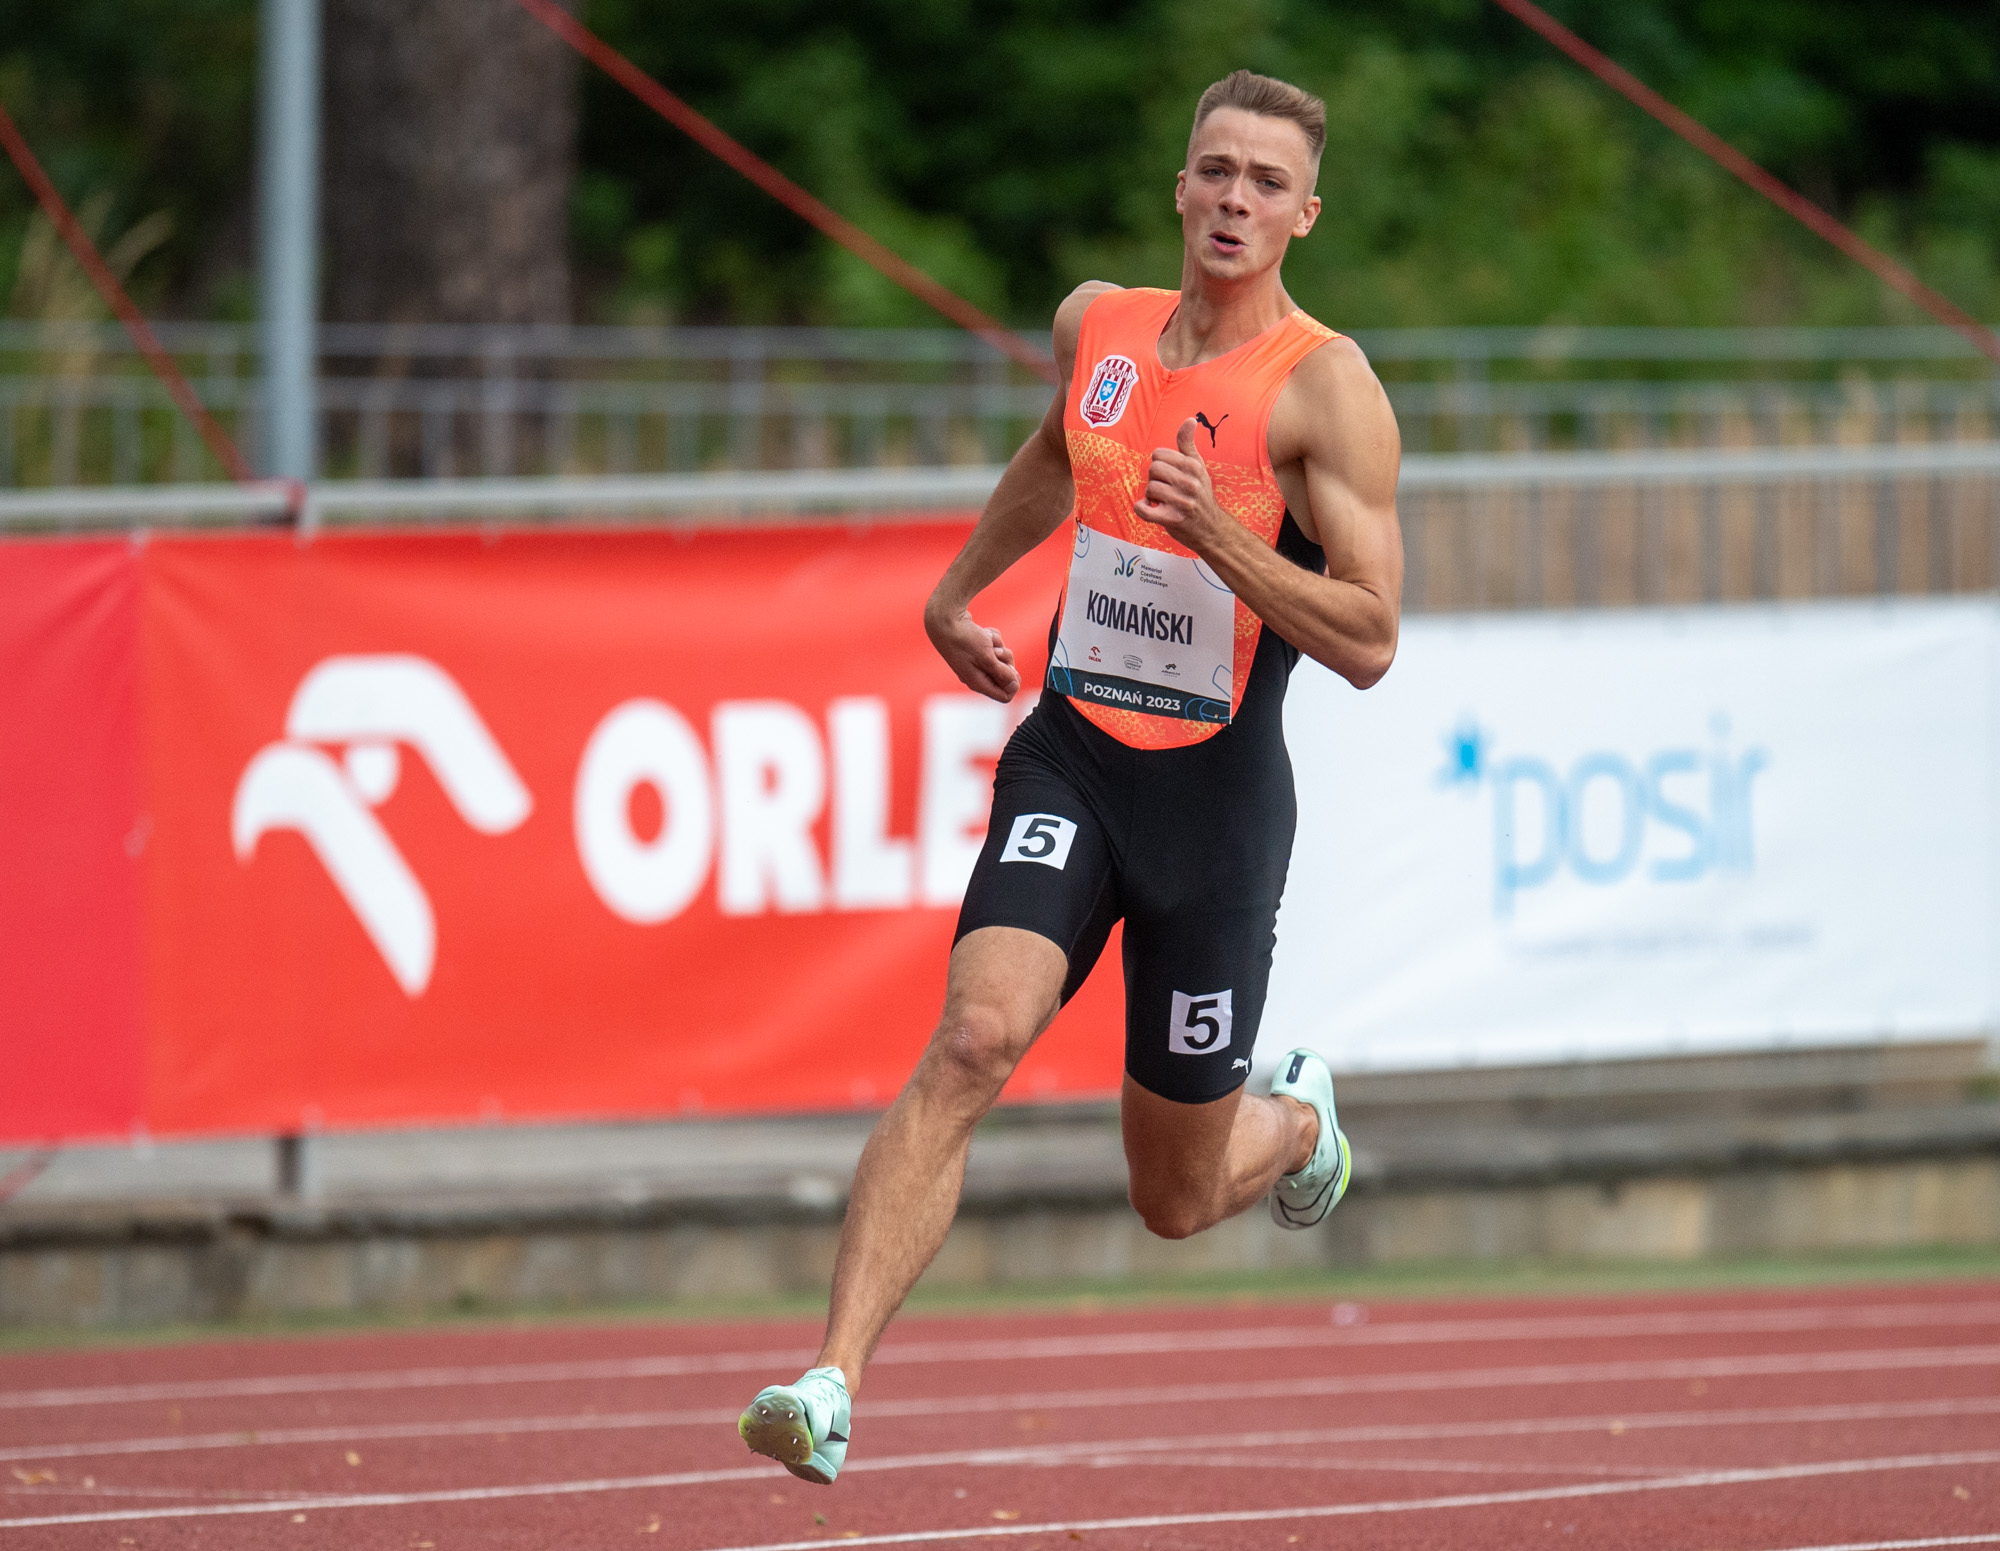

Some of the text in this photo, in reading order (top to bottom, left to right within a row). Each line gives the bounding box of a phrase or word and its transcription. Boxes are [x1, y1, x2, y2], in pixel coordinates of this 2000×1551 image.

[1086, 590, 1193, 645] KOMAŃSKI
[1084, 682, 1181, 711] POZNAŃ 2023
[573, 693, 1041, 926] ORLE
[1492, 708, 1770, 922] posir
[1018, 818, 1061, 858] 5
[1184, 999, 1220, 1050] 5
